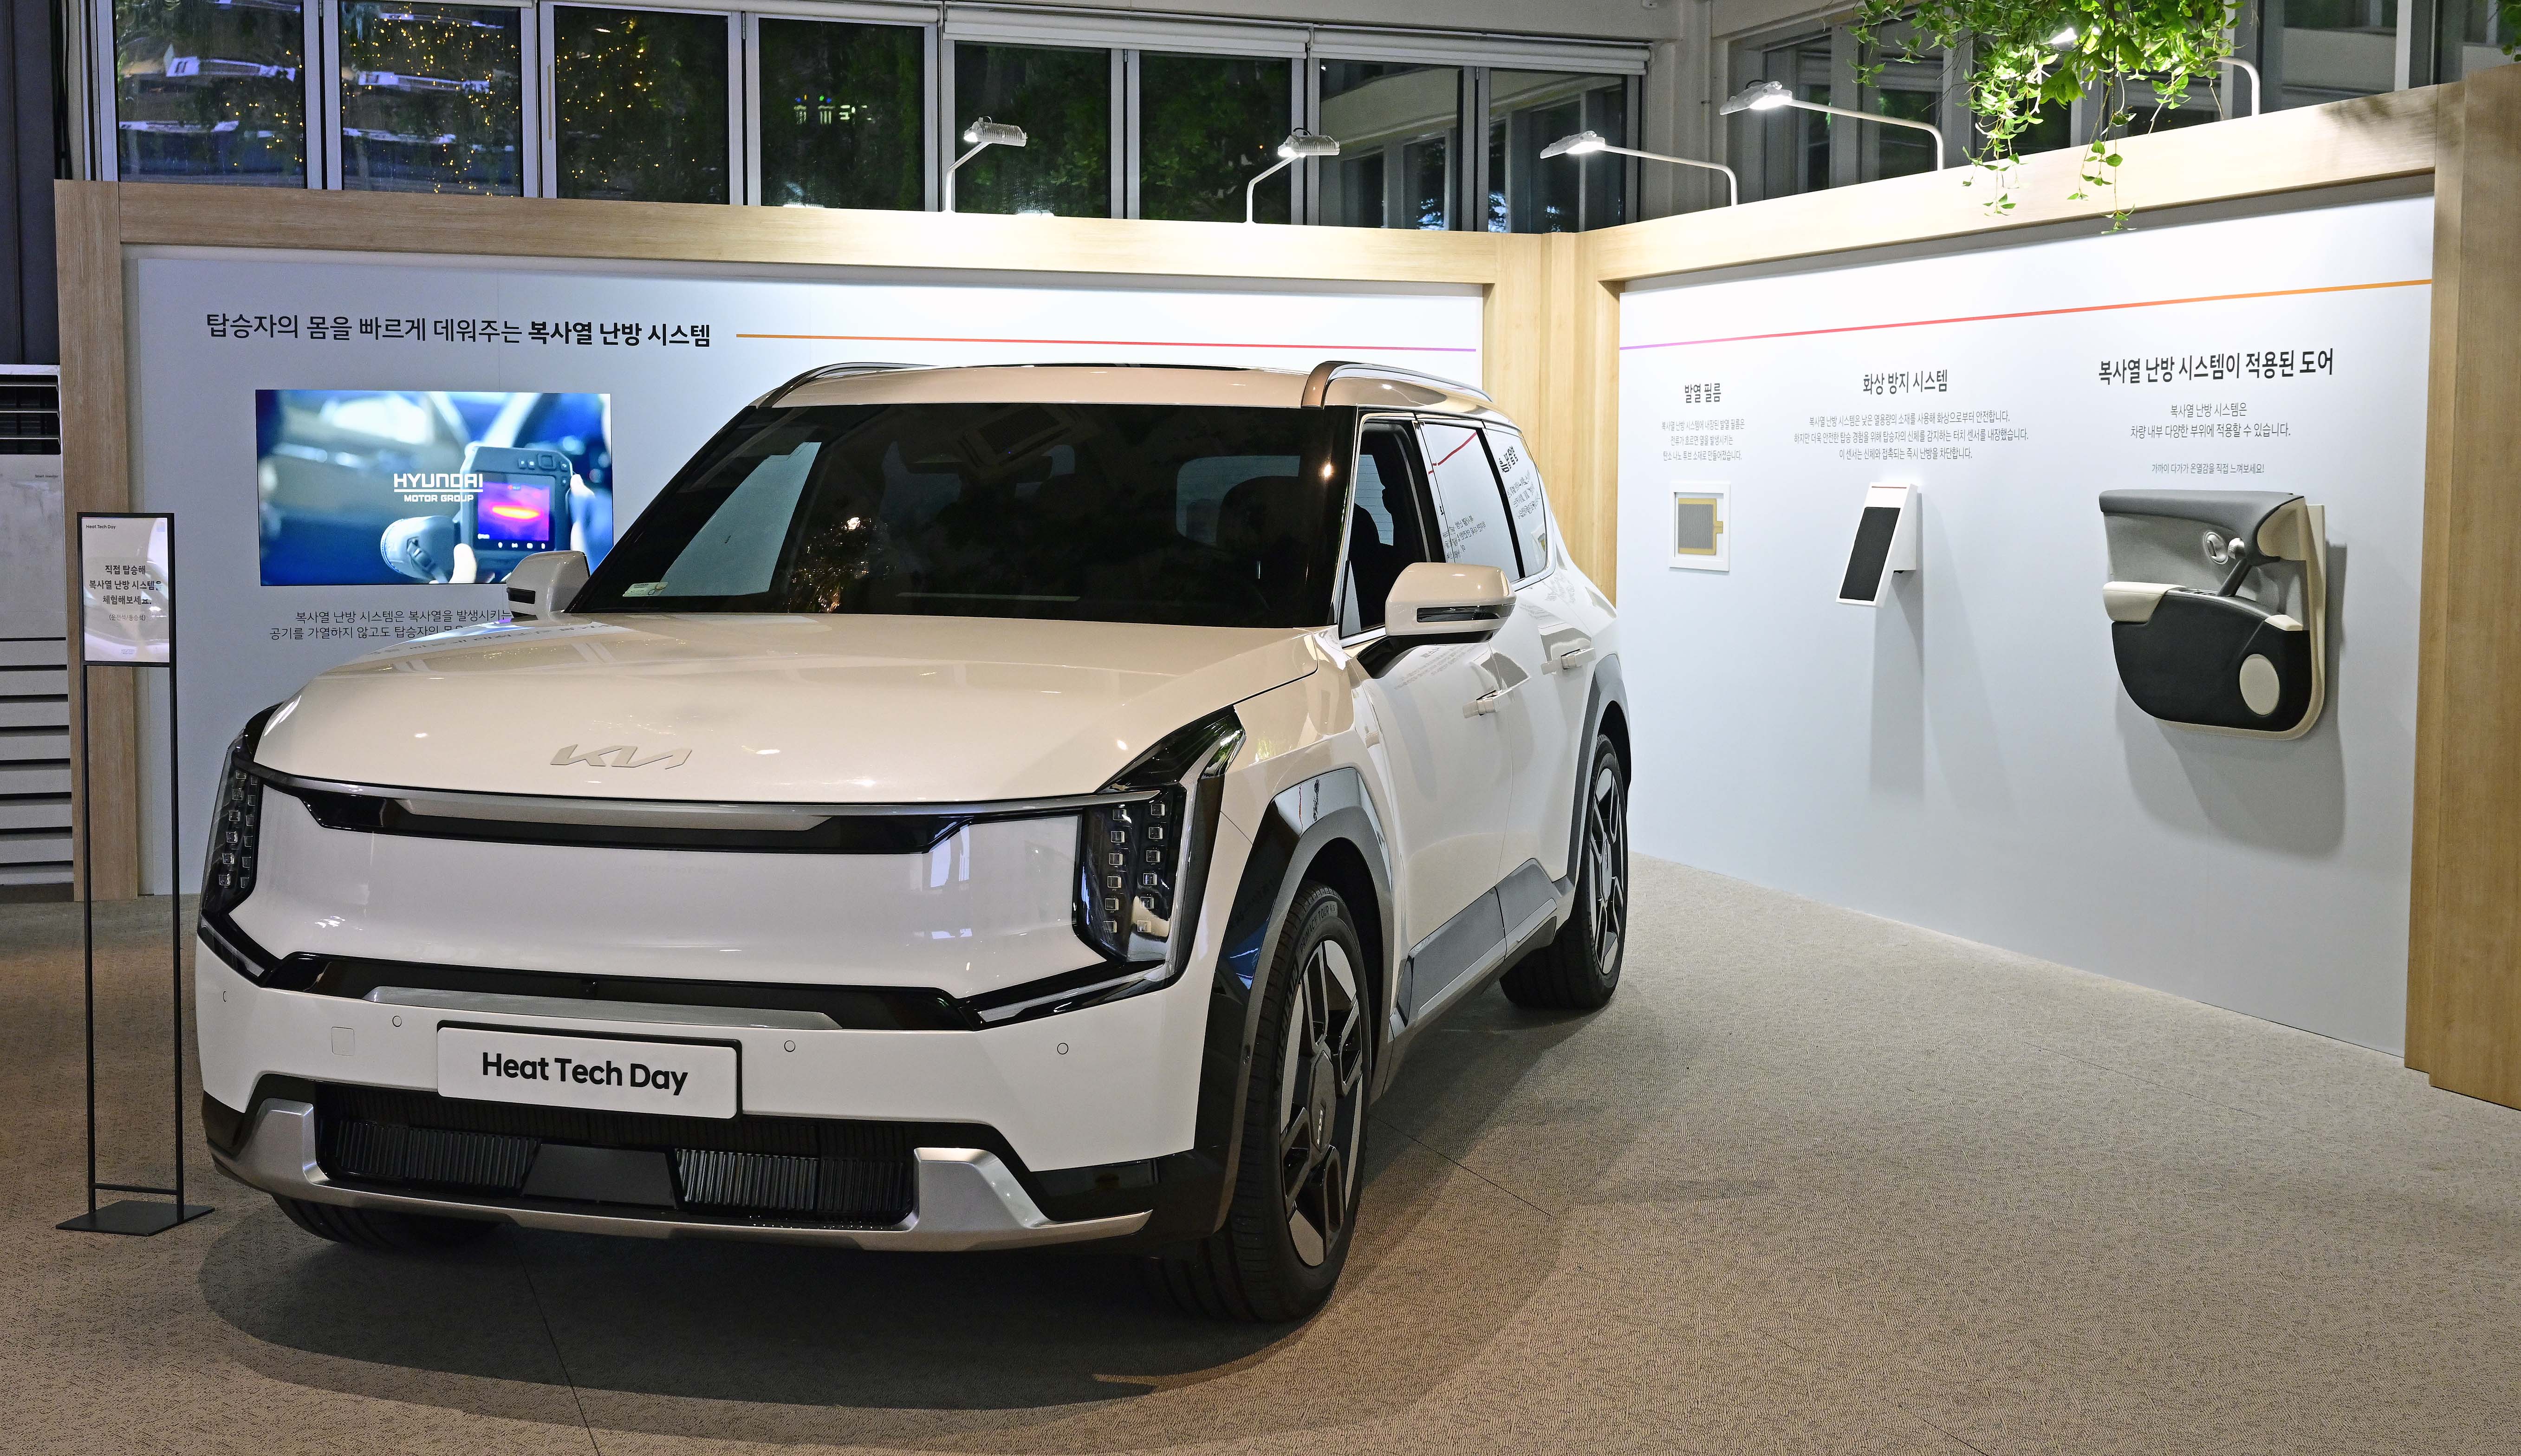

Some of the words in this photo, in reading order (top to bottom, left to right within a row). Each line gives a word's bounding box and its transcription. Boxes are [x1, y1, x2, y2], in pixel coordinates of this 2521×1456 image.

[207, 313, 298, 338] 탑승자의
[307, 316, 352, 340] 몸을
[360, 317, 425, 341] 빠르게
[434, 319, 522, 343] 데워주는
[528, 321, 592, 344] 복사열
[600, 323, 642, 346] 난방
[648, 324, 709, 347] 시스템
[2099, 358, 2140, 385] 복사열
[2146, 357, 2175, 382] 난방
[2179, 353, 2240, 380] 시스템이
[2246, 350, 2294, 378] 적용된
[2300, 348, 2333, 375] 도어
[1863, 373, 1884, 395] 화상
[1888, 371, 1909, 394] 방지
[1913, 370, 1947, 392] 시스템
[1685, 384, 1701, 403] 발열
[1704, 383, 1721, 402] 필름
[2170, 404, 2193, 417] 복사열
[2196, 403, 2212, 417] 난방
[2215, 403, 2247, 416] 시스템은
[1809, 416, 1825, 427] 복사열
[1827, 416, 1837, 427] 난방
[1839, 415, 1860, 426] 시스템은
[1862, 415, 1872, 426] 낮은
[1874, 414, 1897, 426] 열용량의
[1898, 413, 1916, 424] 소재를
[1917, 413, 1935, 424] 사용해
[1937, 411, 1974, 424] 화상으로부터
[1976, 410, 2009, 423] 안전합니다.
[1794, 433, 1810, 444] 하지만
[1812, 433, 1821, 443] 더욱
[1823, 432, 1839, 443] 안전한
[1840, 432, 1851, 443] 탑승
[1852, 431, 1869, 443] 경험을
[1871, 431, 1881, 442] 위해
[1883, 431, 1905, 442] 탑승자의
[1908, 430, 1925, 442] 신체를
[1927, 429, 1951, 442] 감지하는
[1954, 429, 1965, 442] 터치
[1967, 429, 1986, 441] 센서를
[2131, 425, 2146, 439] 차량
[2148, 425, 2163, 438] 내부
[2165, 424, 2188, 438] 다양한
[2190, 424, 2214, 437] 부위에
[2217, 423, 2241, 437] 적용할
[2243, 424, 2252, 437] 수
[2254, 423, 2290, 437] 있습니다.
[1839, 449, 1844, 460] 이
[1846, 448, 1863, 460] 센서는
[1864, 448, 1880, 459] 신체와
[1882, 448, 1905, 460] 접촉되는
[1906, 448, 1918, 459] 즉시
[1920, 448, 1938, 459] 난방을
[1940, 447, 1972, 459] 차단합니다.
[2152, 463, 2169, 474] 가까이
[2171, 463, 2189, 474] 다가가
[2190, 463, 2215, 474] 온열감을
[2216, 464, 2228, 474] 직접
[394, 473, 483, 488] HYUNDAI
[105, 565, 120, 574] 직접
[123, 566, 145, 575] 탑승해
[89, 580, 111, 590] 복사열
[115, 580, 130, 590] 난방
[296, 611, 329, 624] 복사열
[334, 611, 356, 623] 난방
[360, 611, 405, 623] 시스템은
[409, 610, 453, 622] 복사열을
[270, 628, 304, 640] 공기를
[308, 627, 352, 639] 가열하지
[357, 627, 390, 638] 않고도
[1319, 905, 1329, 921] TOUR
[483, 1052, 549, 1080] Heat
[554, 1058, 622, 1086] Tech
[630, 1063, 688, 1096] Day
